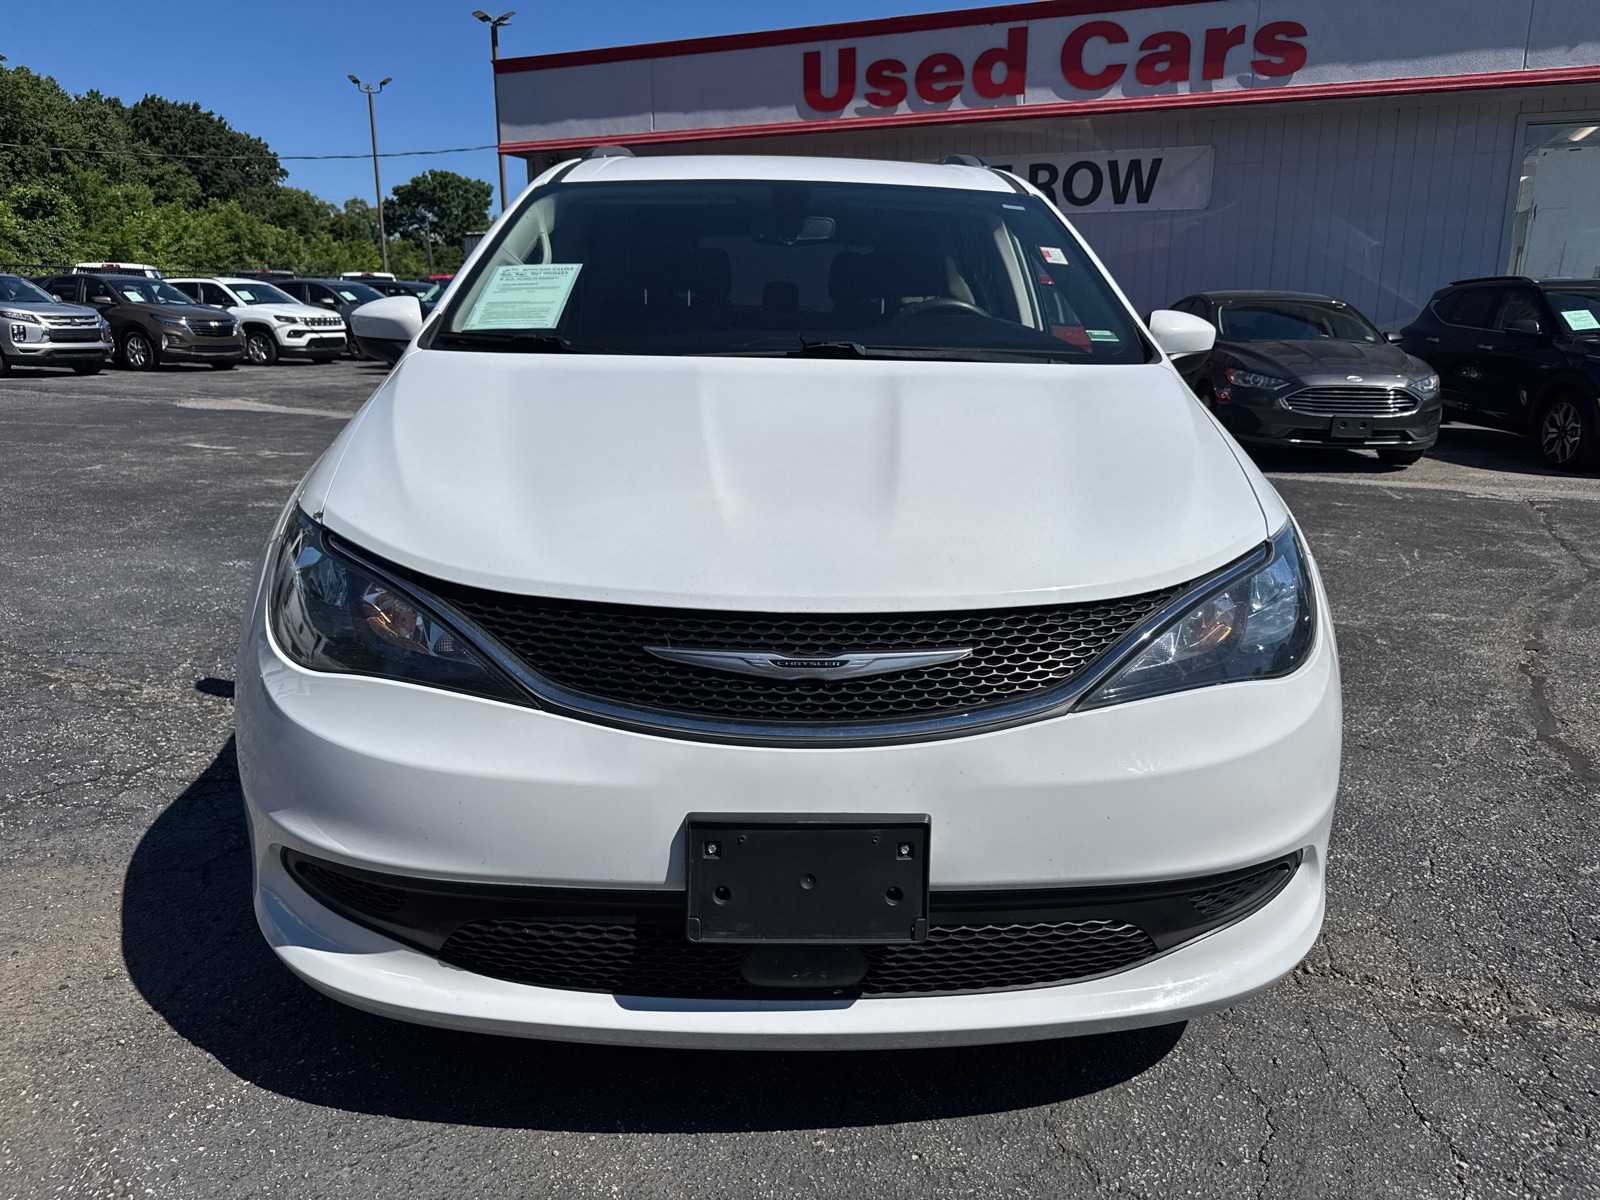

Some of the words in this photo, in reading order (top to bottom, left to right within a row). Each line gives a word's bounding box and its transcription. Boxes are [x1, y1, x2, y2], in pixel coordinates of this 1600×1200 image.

[803, 27, 1028, 112] Used
[1060, 20, 1307, 90] Cars
[1028, 158, 1163, 207] ROW
